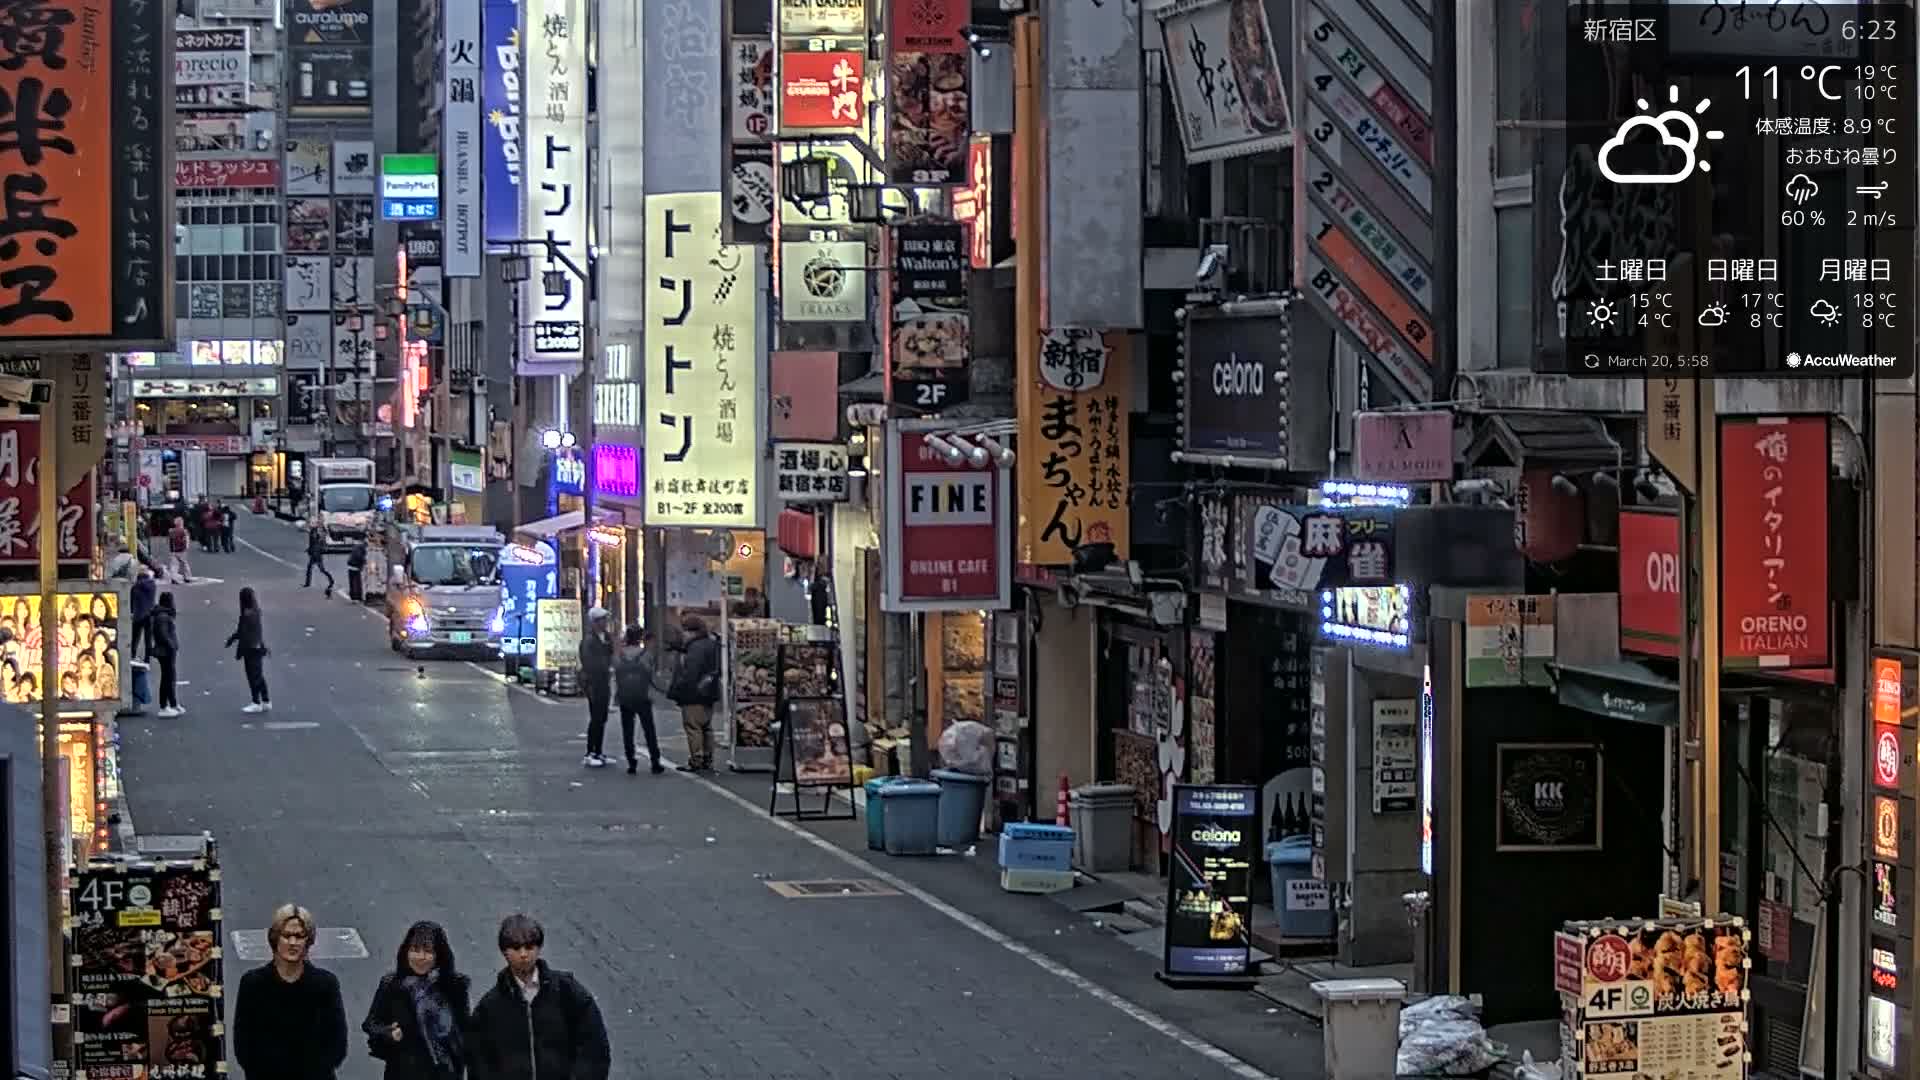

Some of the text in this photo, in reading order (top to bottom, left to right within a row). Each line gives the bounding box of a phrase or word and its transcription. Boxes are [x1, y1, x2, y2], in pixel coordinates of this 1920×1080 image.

[1314, 22, 1334, 42] 5
[450, 39, 475, 104] 火鍋
[542, 14, 569, 123] 焼とん酒場
[831, 58, 860, 121] 牛門
[1314, 74, 1333, 91] 4
[1314, 121, 1334, 143] 3
[386, 180, 436, 192] FamilyMart
[1312, 171, 1333, 192] 2
[1311, 267, 1339, 298] B1
[660, 209, 692, 462] トントン
[713, 325, 737, 444] 焼とん酒場
[1212, 353, 1265, 397] celona
[916, 384, 946, 405] 2F
[778, 474, 845, 493] 新宿本店
[1041, 395, 1086, 550] まっちゃん
[654, 478, 749, 495] 新宿歌舞伎町店
[911, 484, 986, 513] FINE
[1348, 519, 1389, 535] フリー
[1754, 431, 1788, 603] 俺のイタリアン
[1741, 614, 1808, 633] ORENO
[1740, 634, 1809, 651] ITALIAN
[1191, 828, 1242, 843] celona
[79, 877, 124, 910] 4F
[1589, 988, 1623, 1011] 4F
